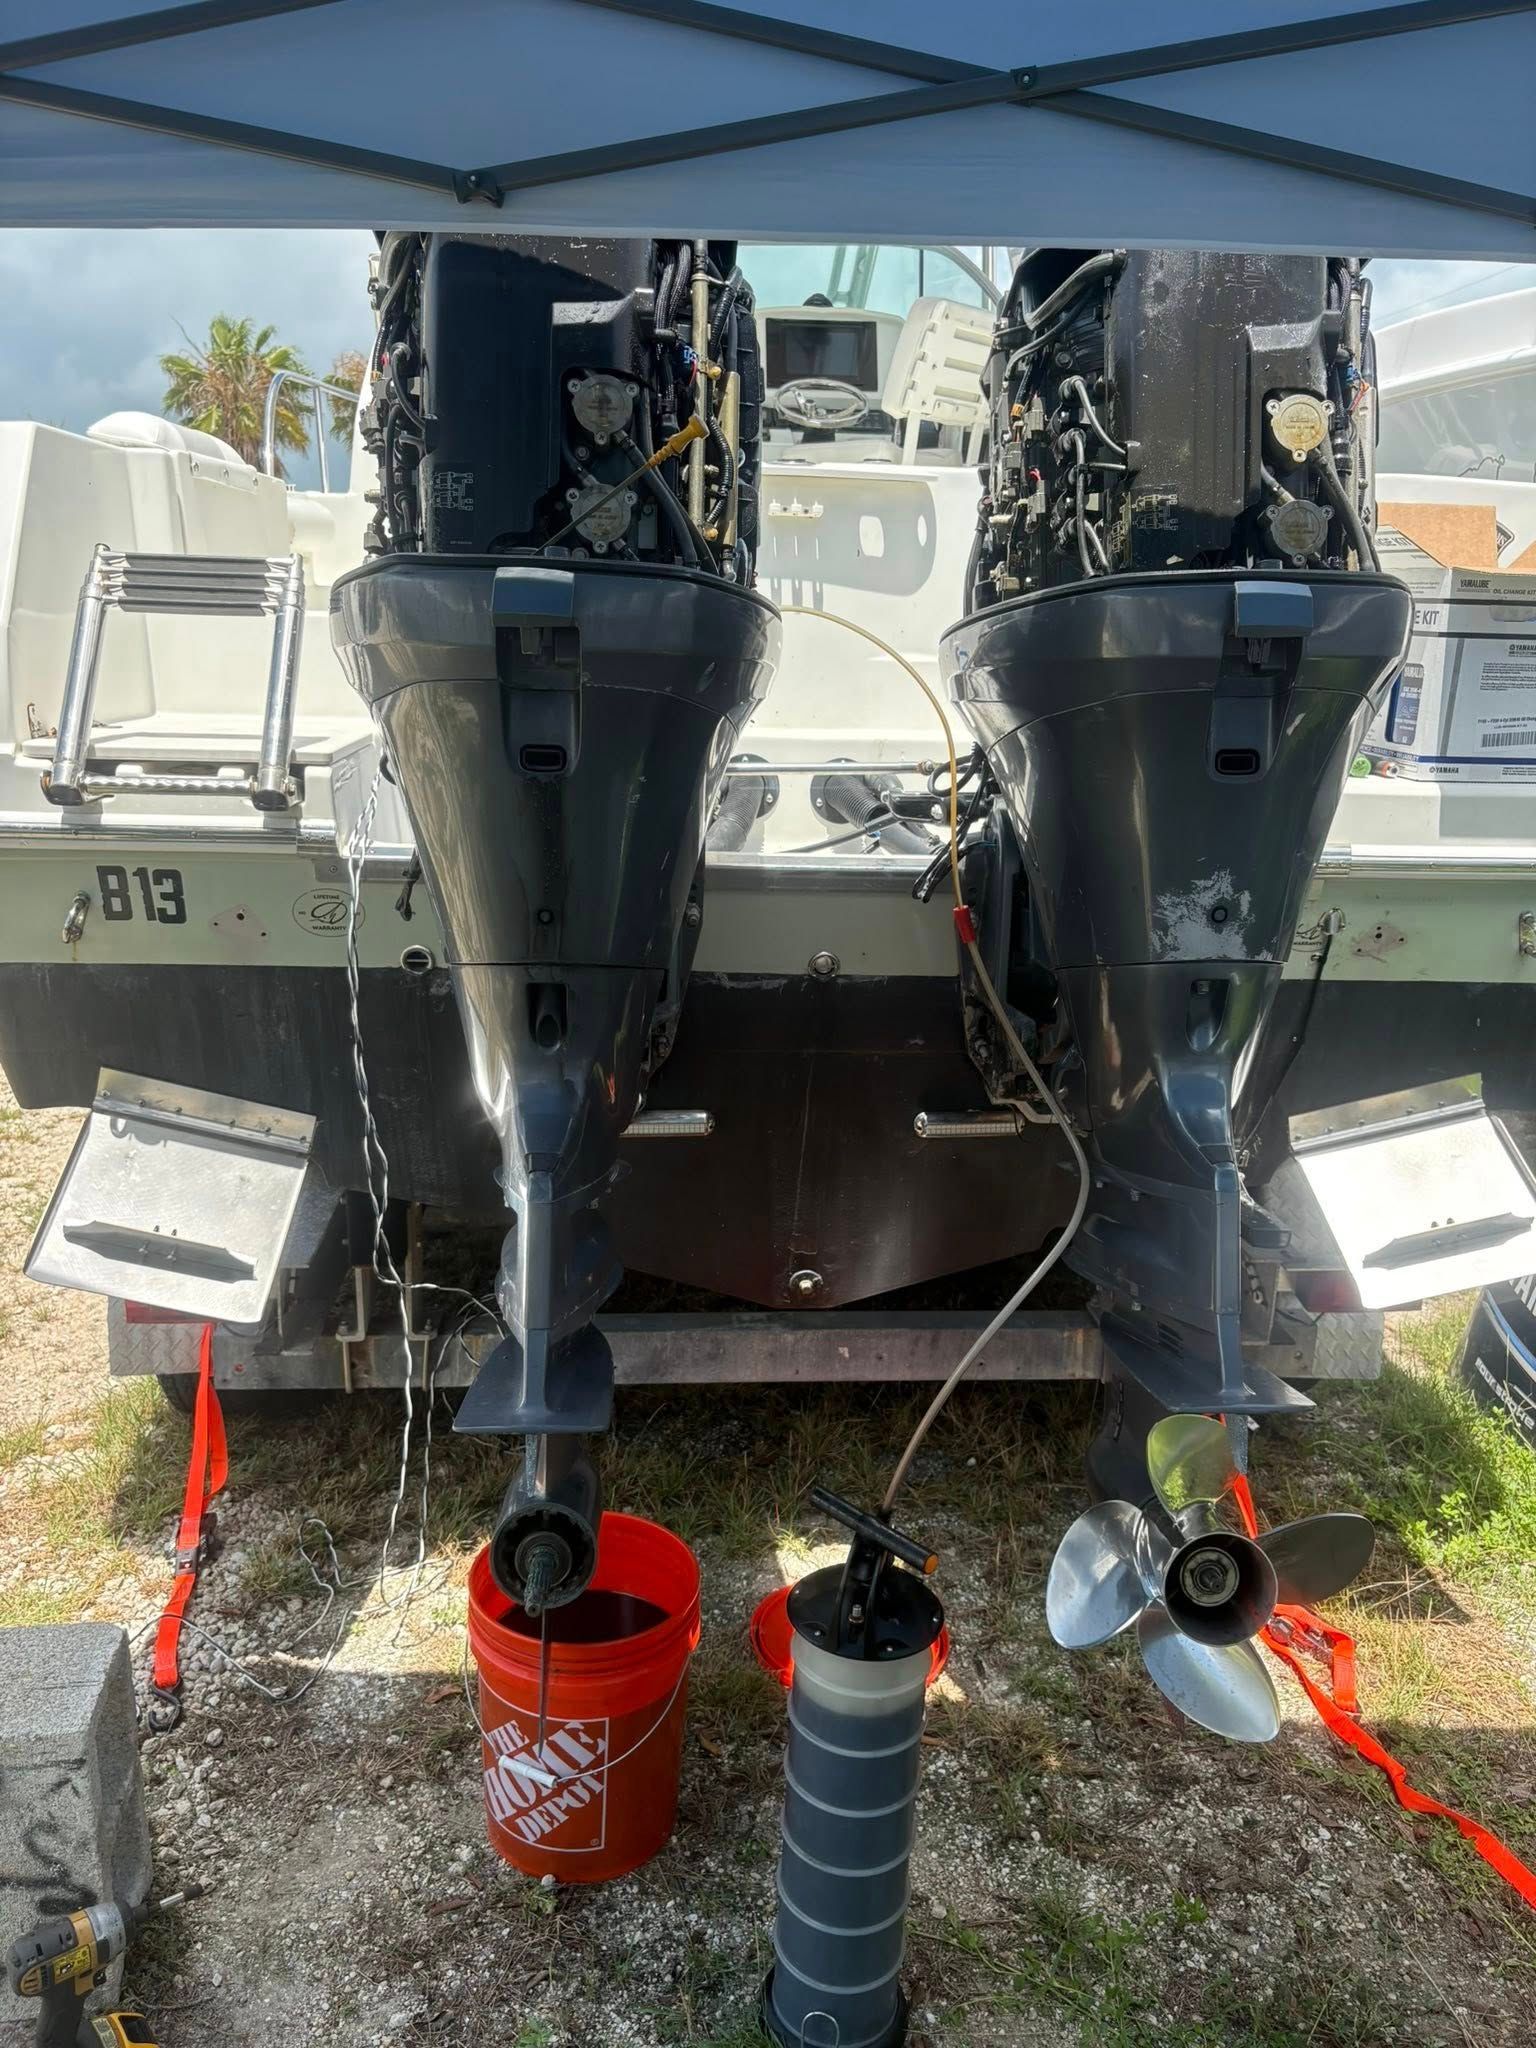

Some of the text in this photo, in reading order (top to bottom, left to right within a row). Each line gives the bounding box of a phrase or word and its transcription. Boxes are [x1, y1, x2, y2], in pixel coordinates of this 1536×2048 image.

[1422, 610, 1440, 625] KIT
[486, 1719, 530, 1755] THE
[484, 1720, 607, 1821] HOME
[514, 1770, 605, 1843] DEPOT
